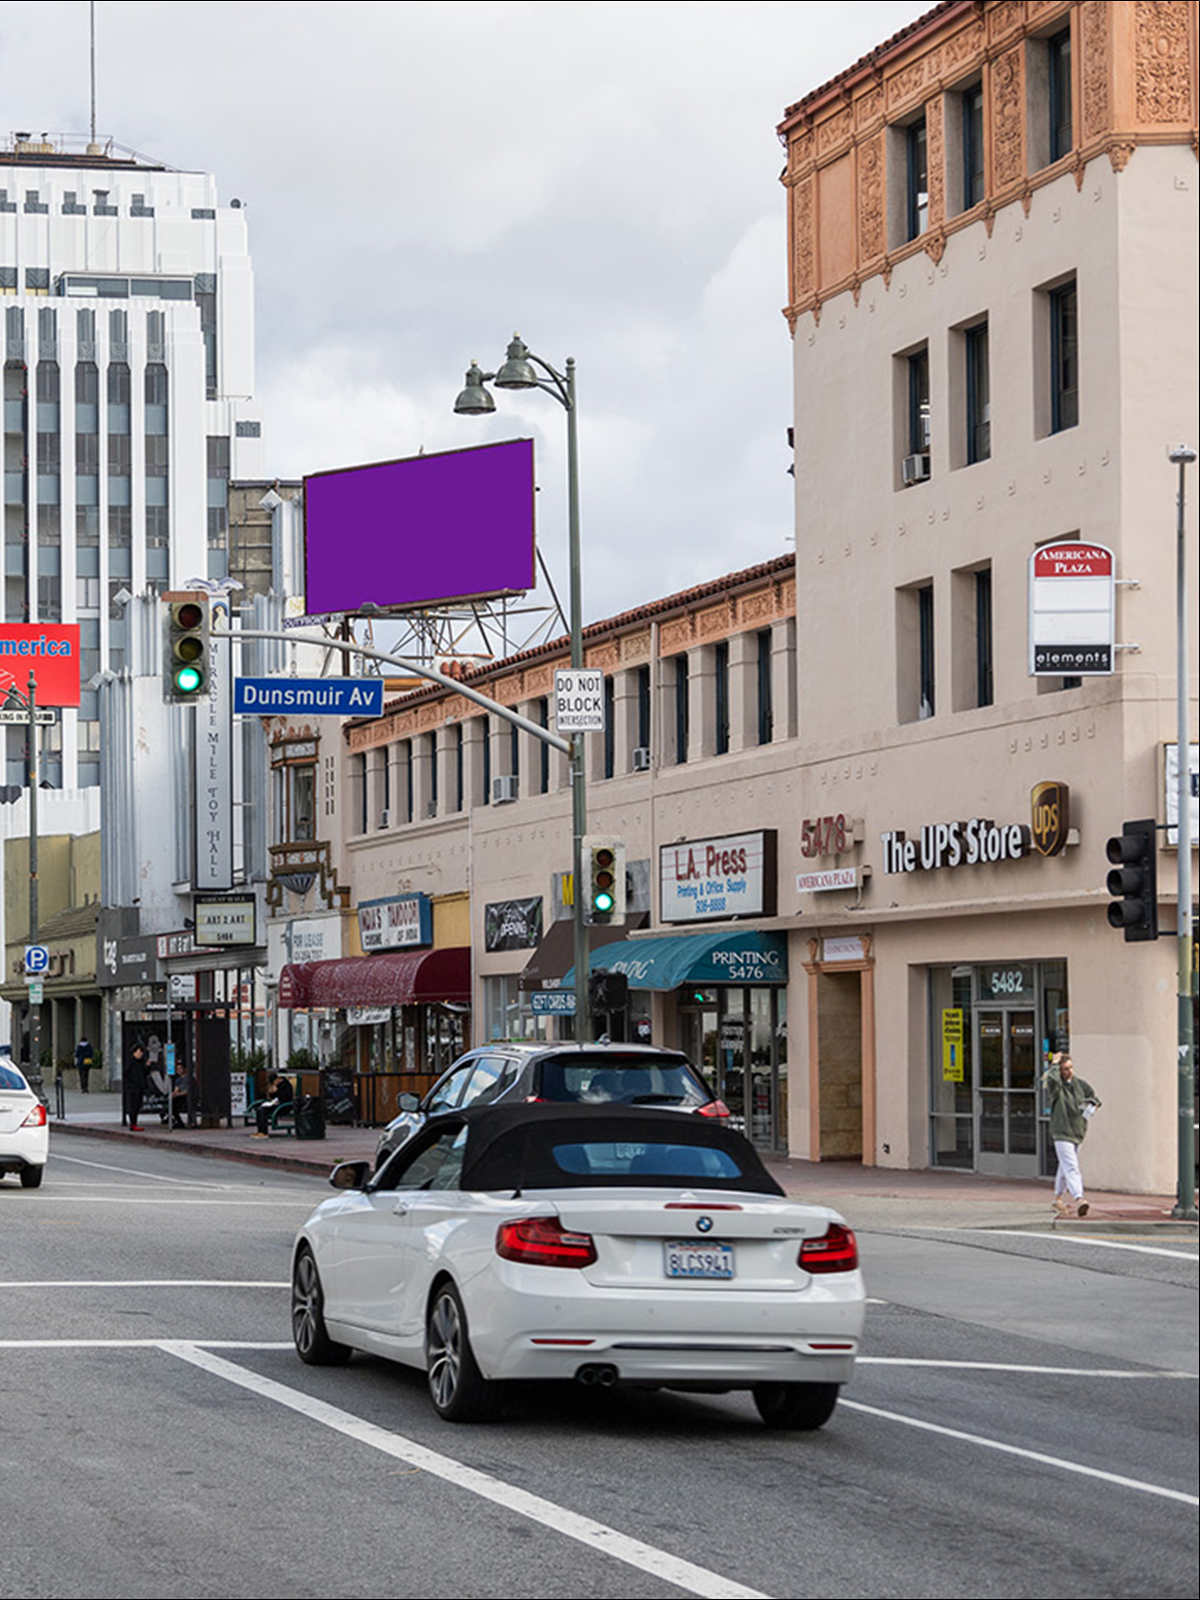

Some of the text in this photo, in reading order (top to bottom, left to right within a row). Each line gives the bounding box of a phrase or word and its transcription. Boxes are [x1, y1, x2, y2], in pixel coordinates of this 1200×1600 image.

[1039, 550, 1107, 561] AMERICANA
[1054, 562, 1092, 573] PLAZA
[1036, 652, 1108, 663] elements
[557, 677, 600, 692] DO NOT
[243, 685, 374, 706] Dunsmuir Av
[558, 697, 601, 712] BLOCK
[559, 714, 601, 726] INTERSECTION
[206, 643, 220, 878] MIRACLE MILE TOY HALL
[1034, 803, 1059, 845] ups
[801, 813, 847, 858] 5478
[879, 818, 1022, 875] The UPS Store
[675, 845, 747, 880] L.A. Press
[798, 871, 854, 889] AMERICANA PLAZA
[677, 884, 698, 900] Printing
[705, 881, 725, 896] Office
[726, 878, 747, 894] Supply
[712, 951, 779, 965] PRINTING
[728, 966, 764, 979] 5476
[992, 971, 1023, 993] 5482
[670, 1254, 730, 1271] 8LCS941
